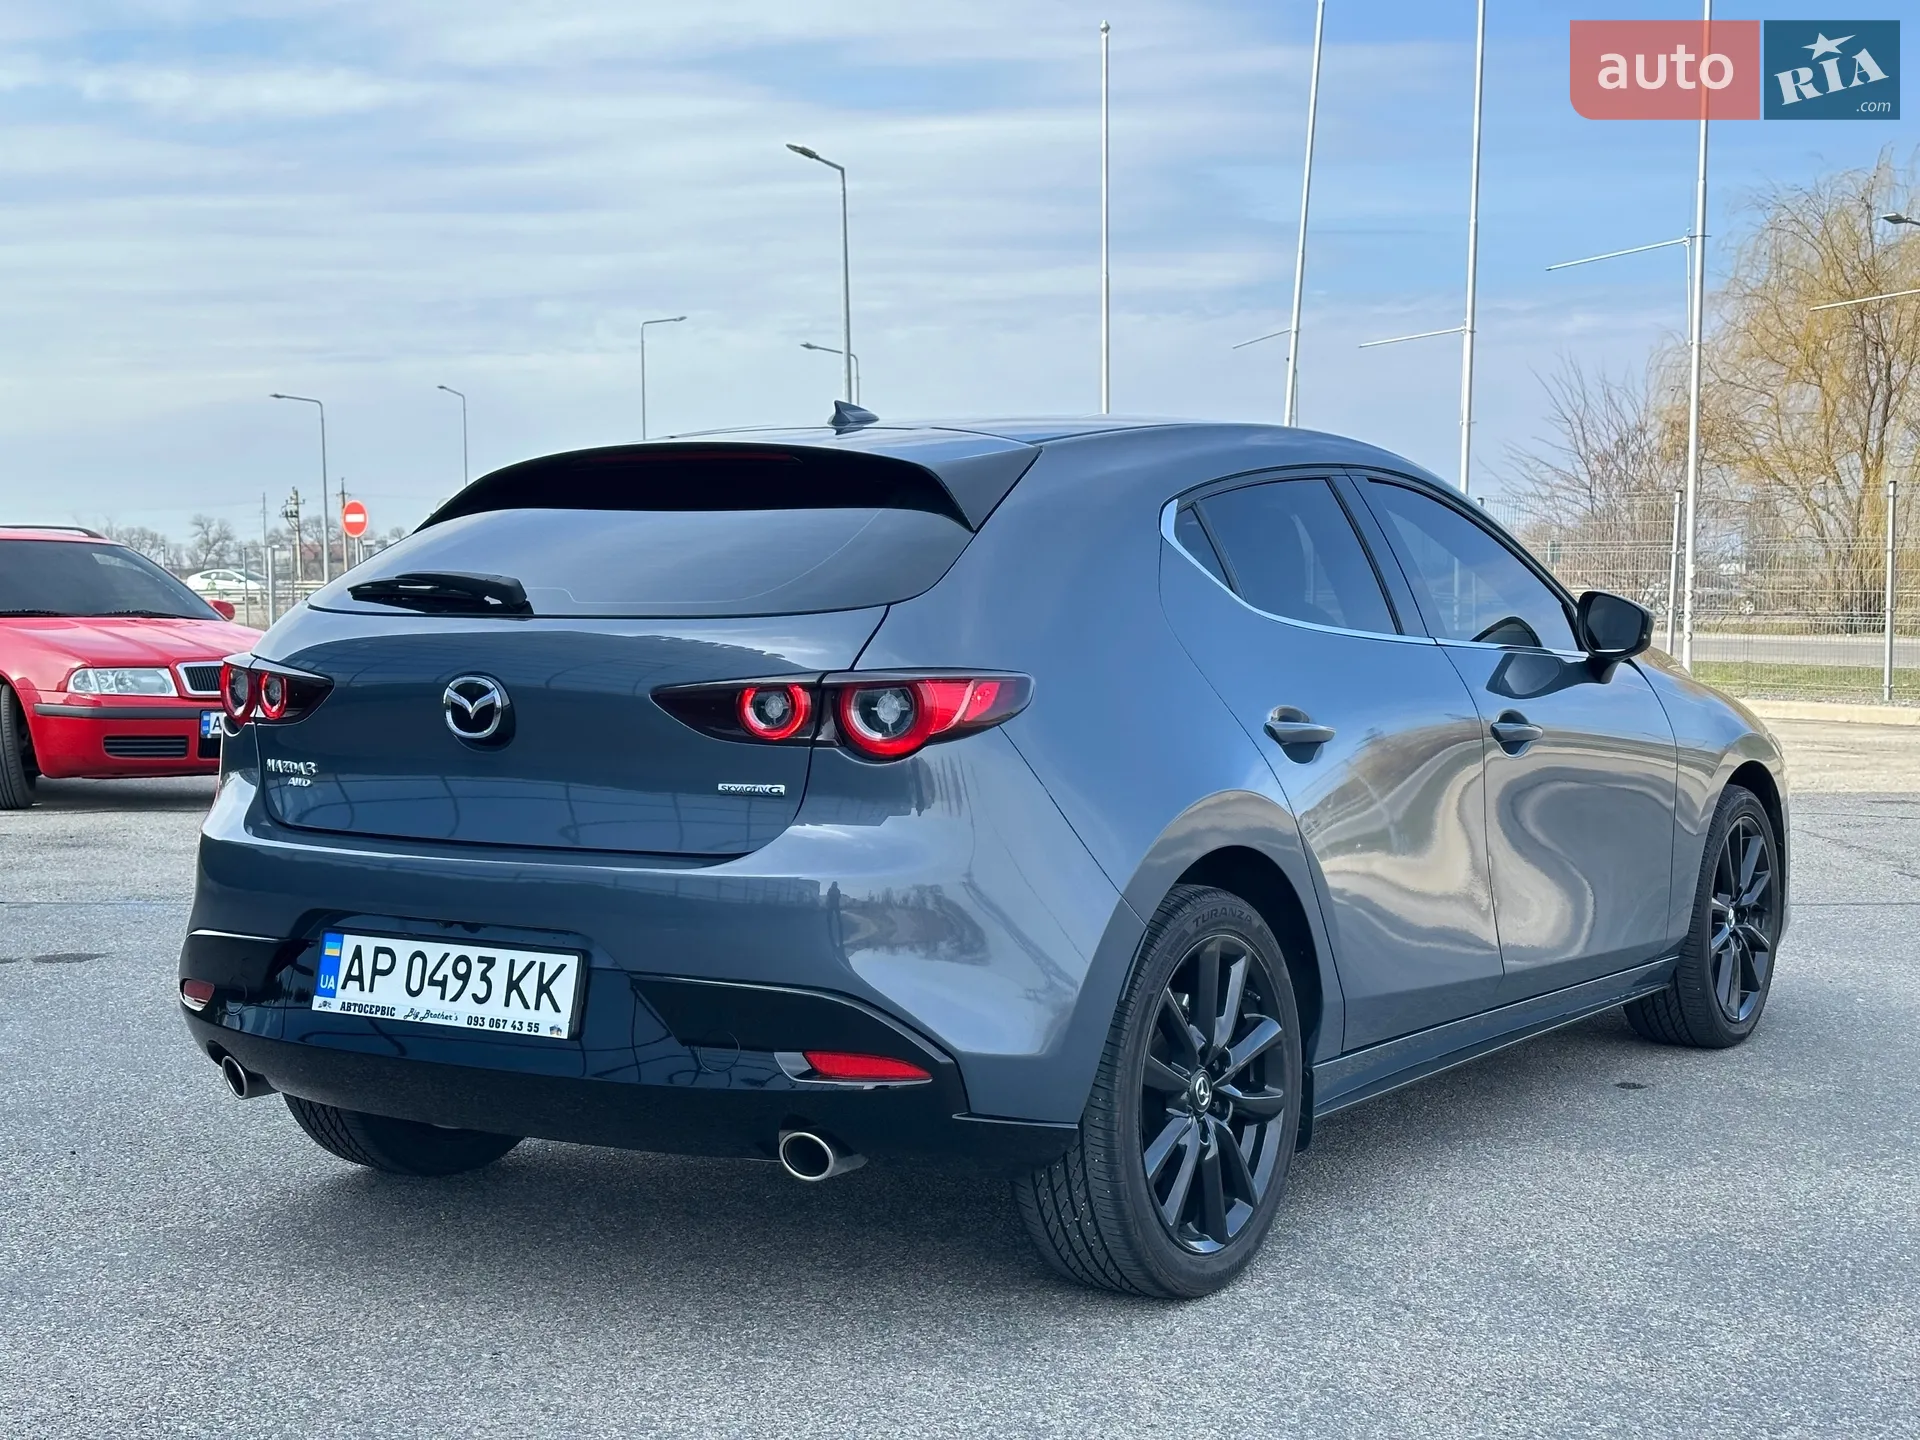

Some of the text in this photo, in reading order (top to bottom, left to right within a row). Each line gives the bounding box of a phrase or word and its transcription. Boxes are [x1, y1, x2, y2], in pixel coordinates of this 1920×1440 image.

[1192, 906, 1253, 928] TURANZA
[319, 973, 335, 990] UA
[340, 944, 568, 1014] AP 0493 KK
[340, 1001, 396, 1017] АВТОСЕРВІС
[403, 1007, 420, 1020] Big
[466, 1015, 540, 1033] 093 067 43 55
